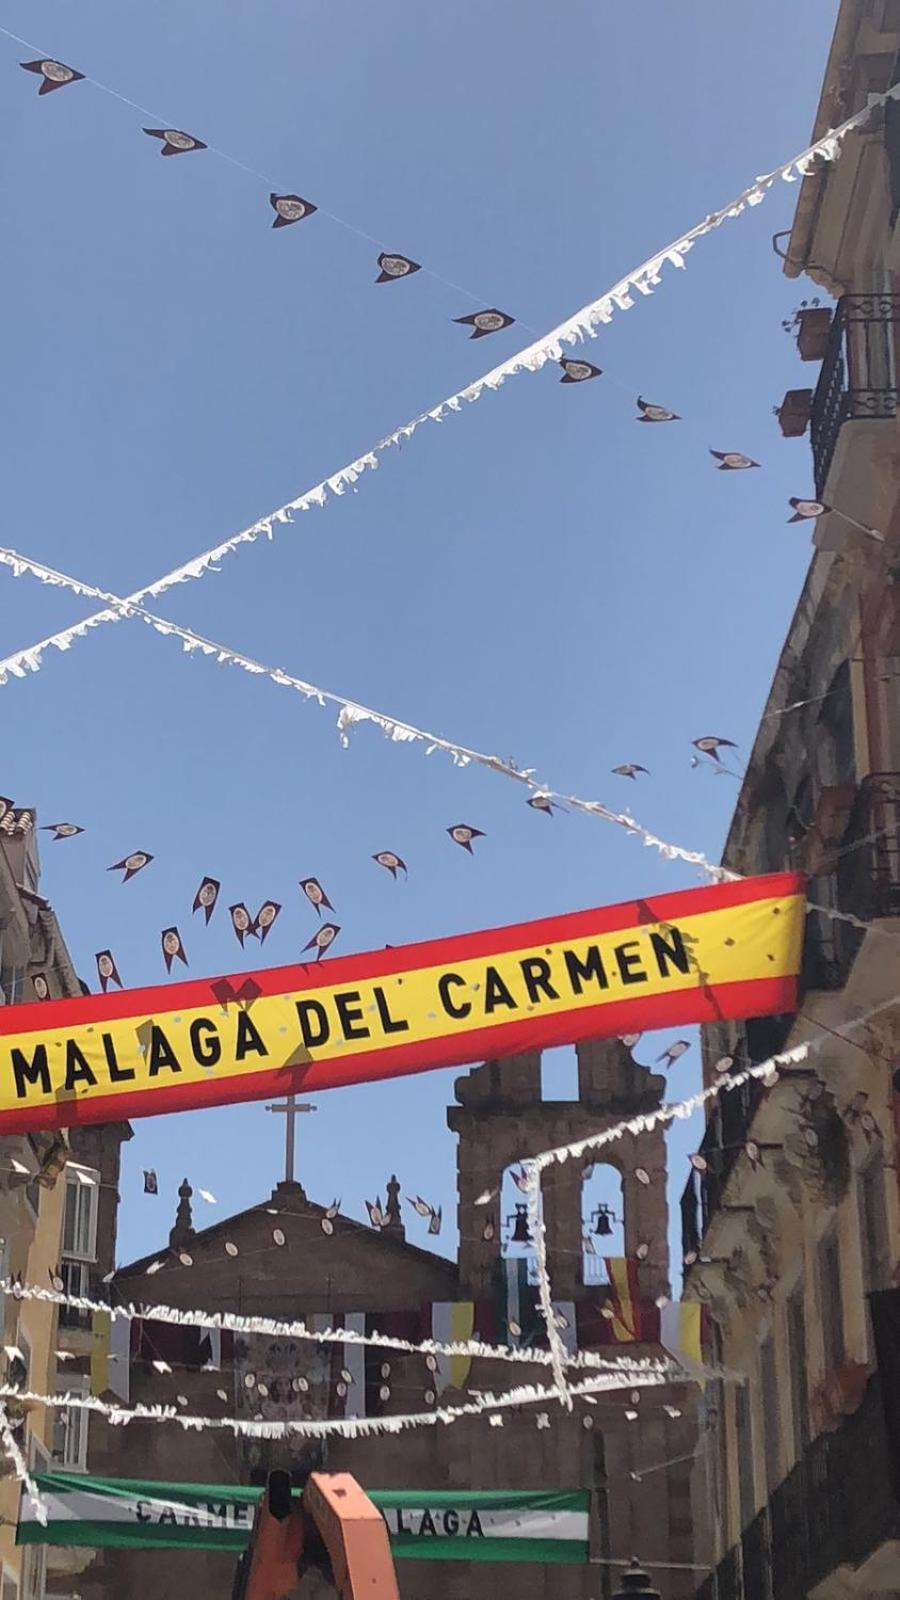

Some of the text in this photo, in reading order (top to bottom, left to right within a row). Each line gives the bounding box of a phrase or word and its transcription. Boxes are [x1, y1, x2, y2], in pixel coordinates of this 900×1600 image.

[10, 927, 692, 1098] MALAGA DEL CARMEN
[136, 1500, 484, 1537] CARME LAGA
